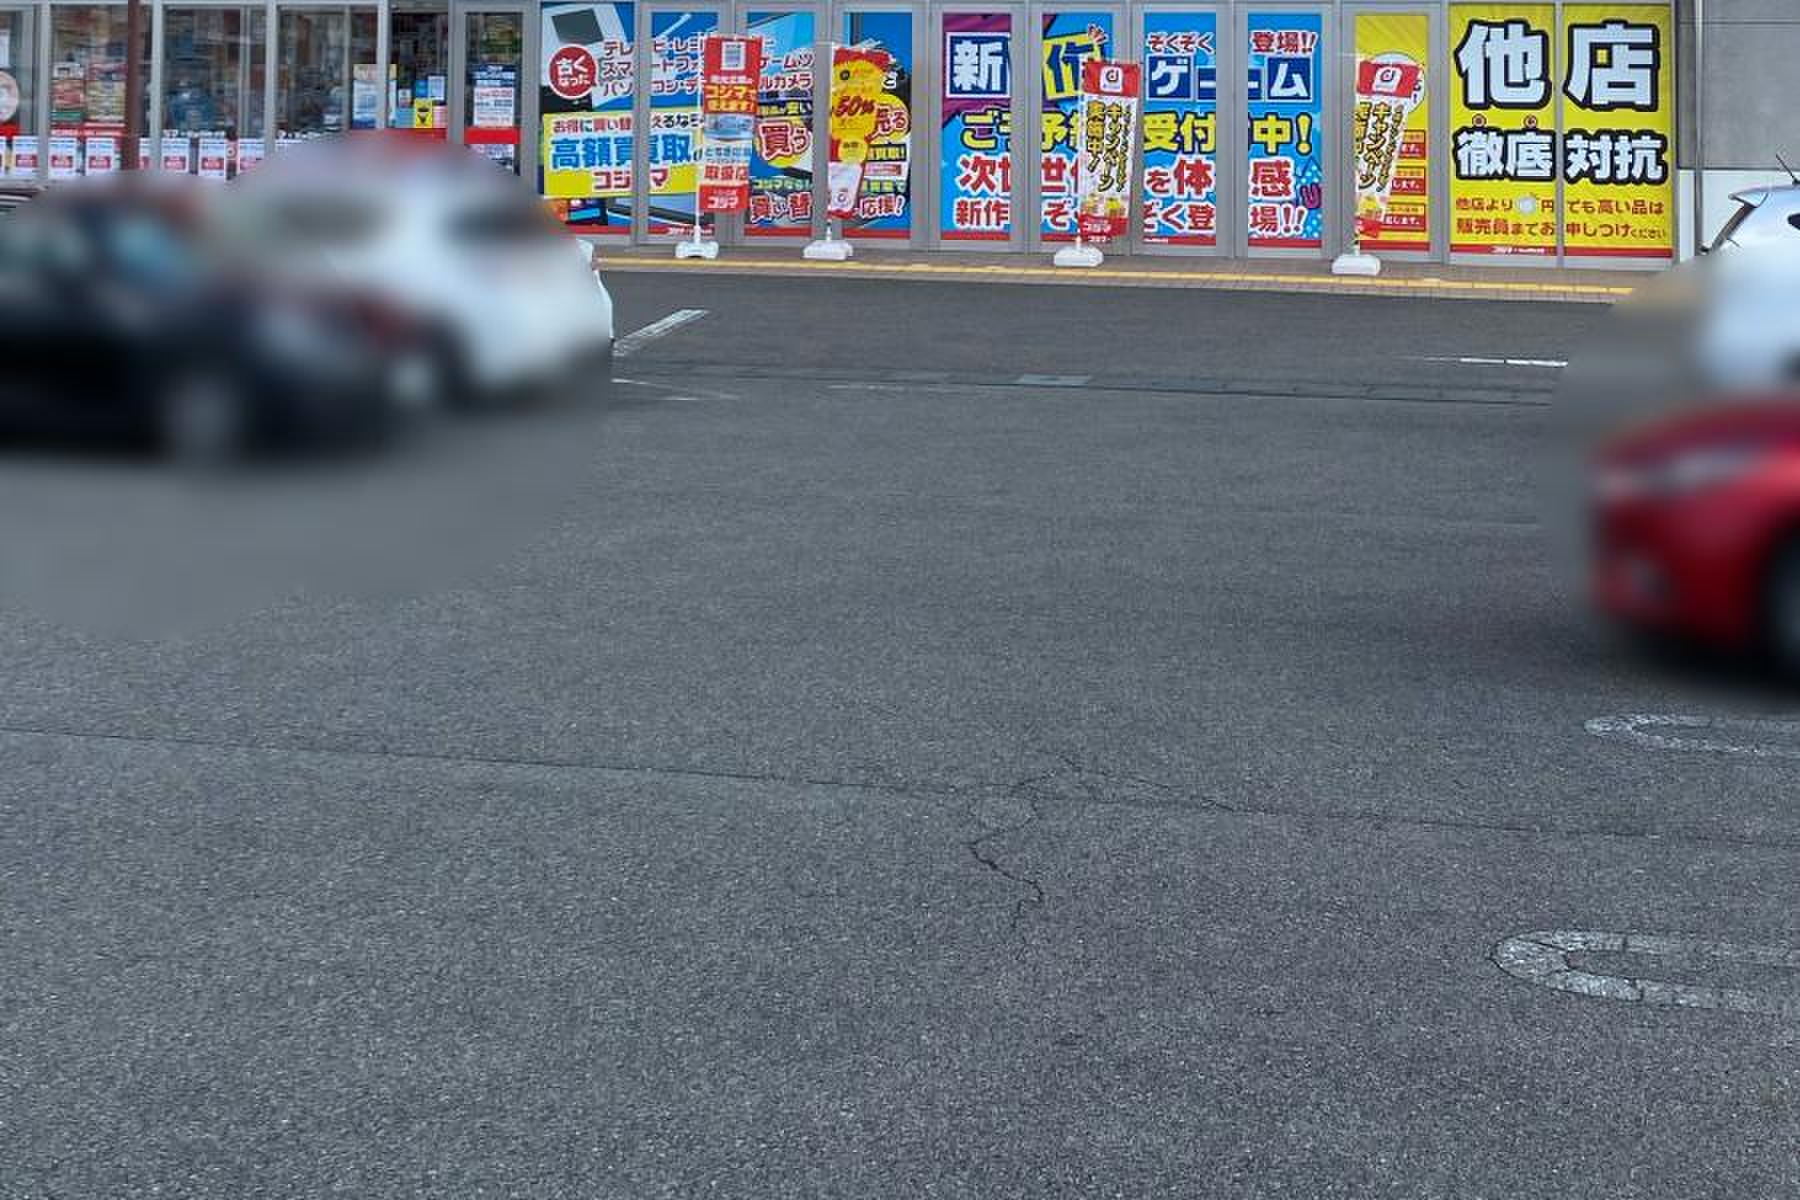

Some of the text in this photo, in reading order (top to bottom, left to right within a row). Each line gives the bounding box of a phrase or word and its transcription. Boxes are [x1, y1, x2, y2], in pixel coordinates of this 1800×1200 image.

[1458, 23, 1656, 106] 他店
[1457, 129, 1664, 181] 徹底対抗
[593, 171, 669, 191] コジマ
[1455, 196, 1664, 215] 他店より円でも高い品は
